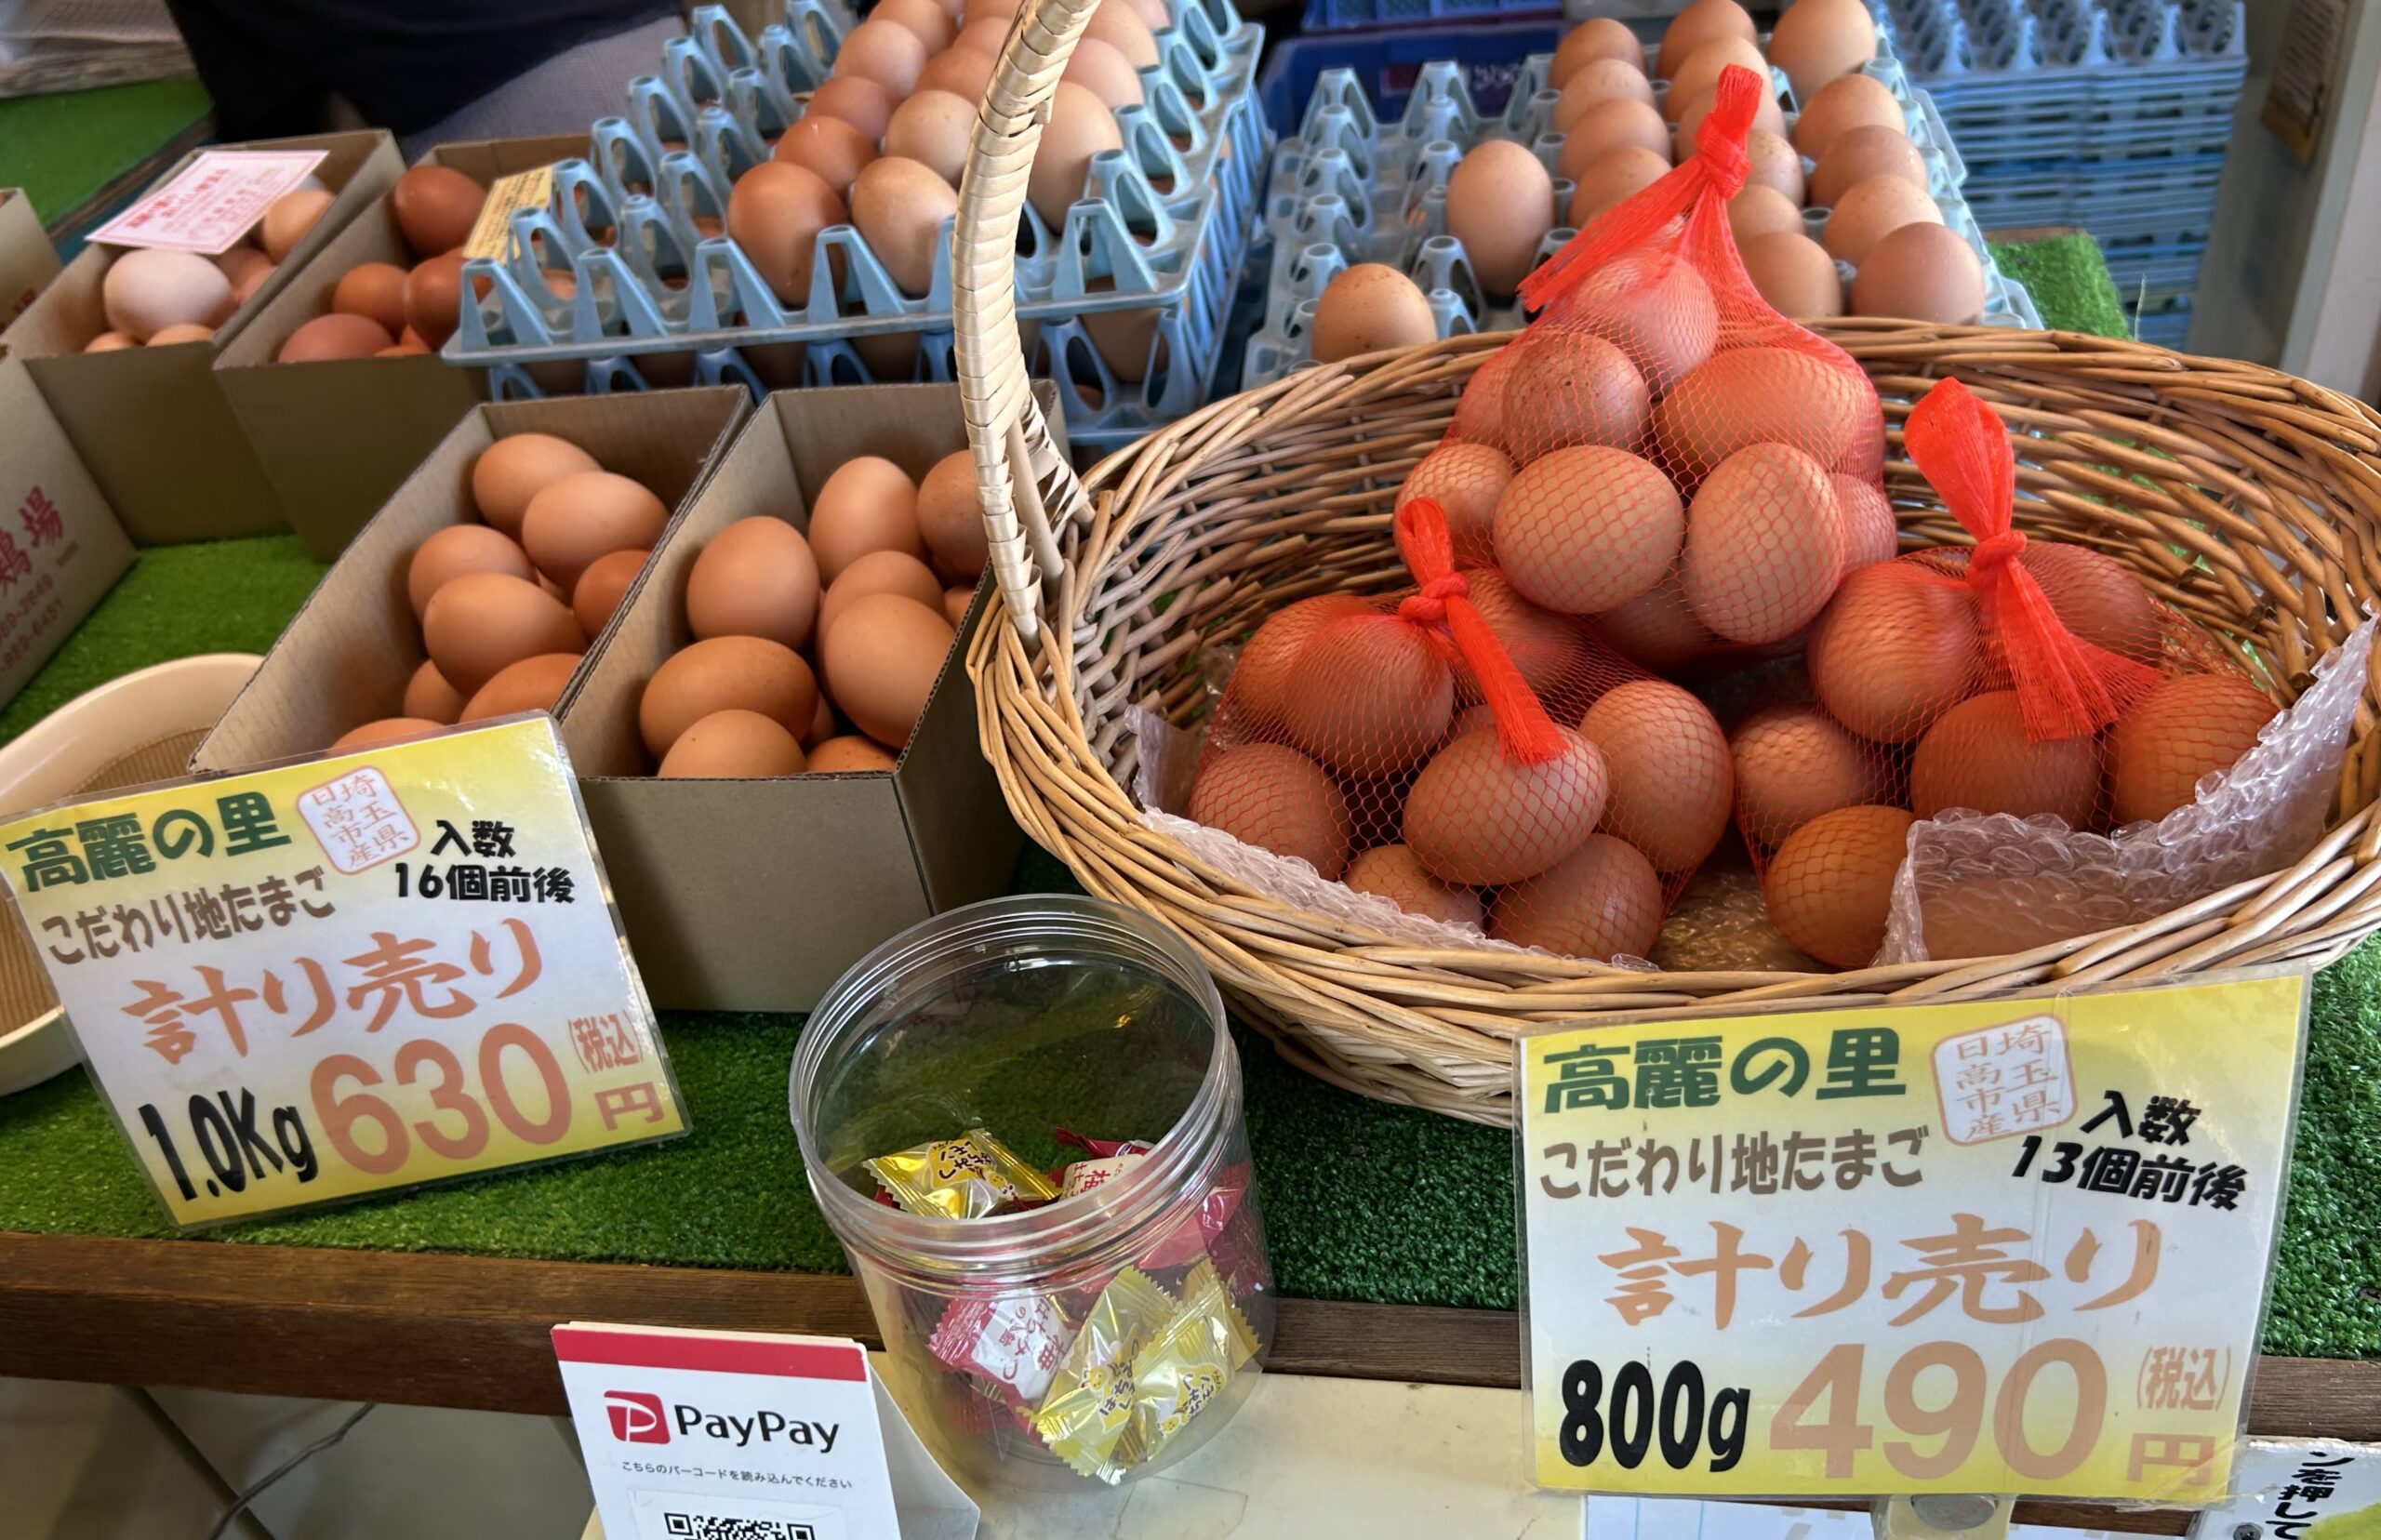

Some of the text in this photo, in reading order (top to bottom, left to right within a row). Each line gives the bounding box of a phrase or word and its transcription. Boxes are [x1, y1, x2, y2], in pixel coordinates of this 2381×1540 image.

[7, 790, 292, 893] 高麗の里
[431, 818, 516, 858] 入数
[41, 866, 336, 964] こだわり地たまご
[393, 862, 576, 904] 16個前後
[121, 917, 543, 1066] 計り売り
[309, 1022, 572, 1175] 630
[595, 1081, 665, 1131] 円
[1544, 1027, 1907, 1114] 高麗の里
[2080, 1089, 2201, 1148] 入数
[1540, 1124, 1932, 1200] こだわり地たまご
[2011, 1135, 2249, 1211] 13個前後
[1598, 1211, 2162, 1330] 計り売り
[674, 1404, 839, 1453] PayPay
[1560, 1336, 2108, 1481] 800g 490
[2126, 1432, 2216, 1484] 円
